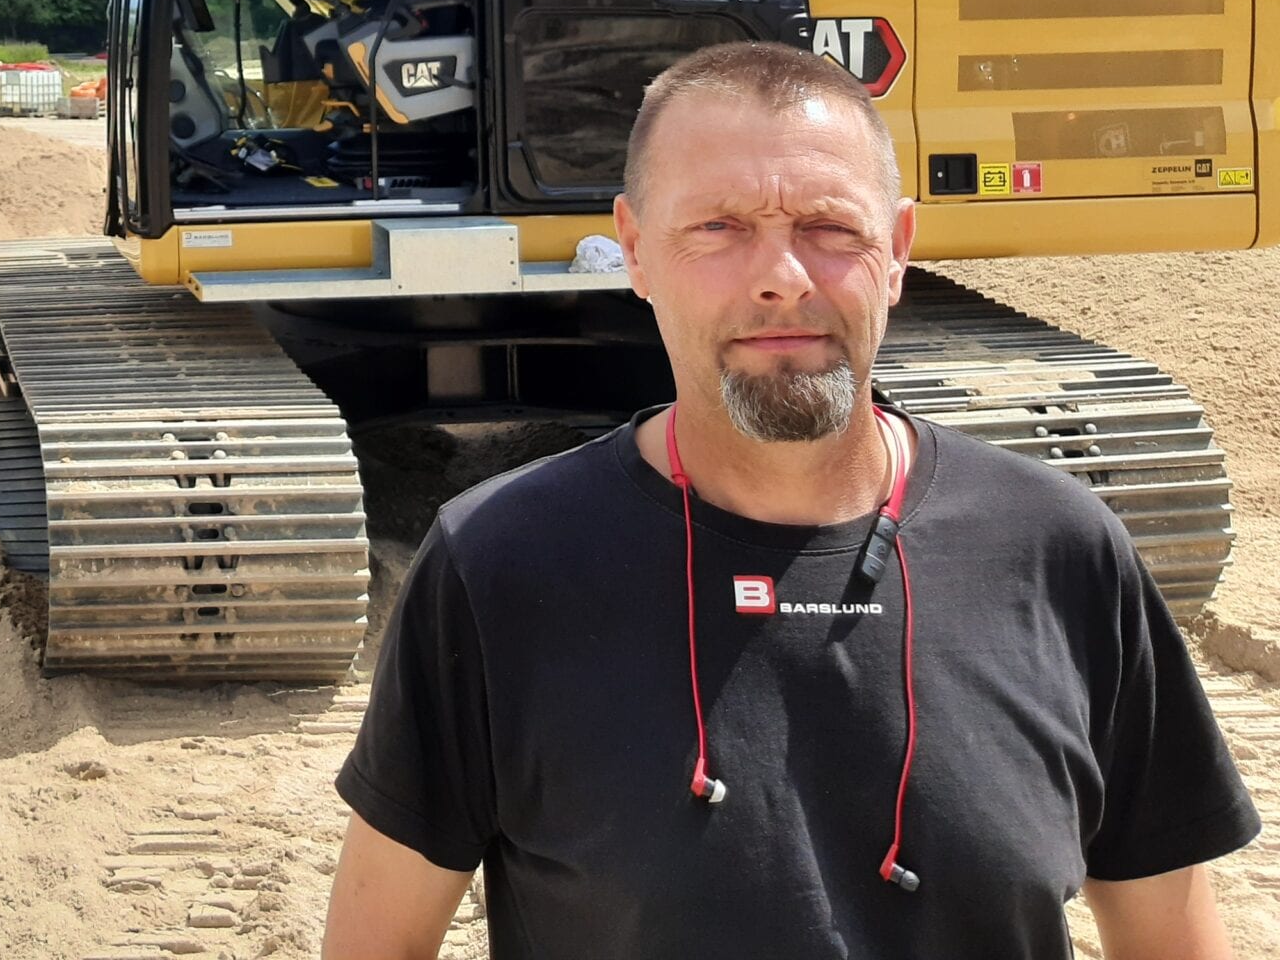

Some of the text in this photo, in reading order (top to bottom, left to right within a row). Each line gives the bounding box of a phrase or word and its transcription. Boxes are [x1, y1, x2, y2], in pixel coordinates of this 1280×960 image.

[812, 18, 873, 80] AT
[401, 60, 441, 89] CAT
[1151, 165, 1192, 174] ZEPPELIN
[734, 580, 770, 607] B
[779, 603, 883, 614] BARSLUND
